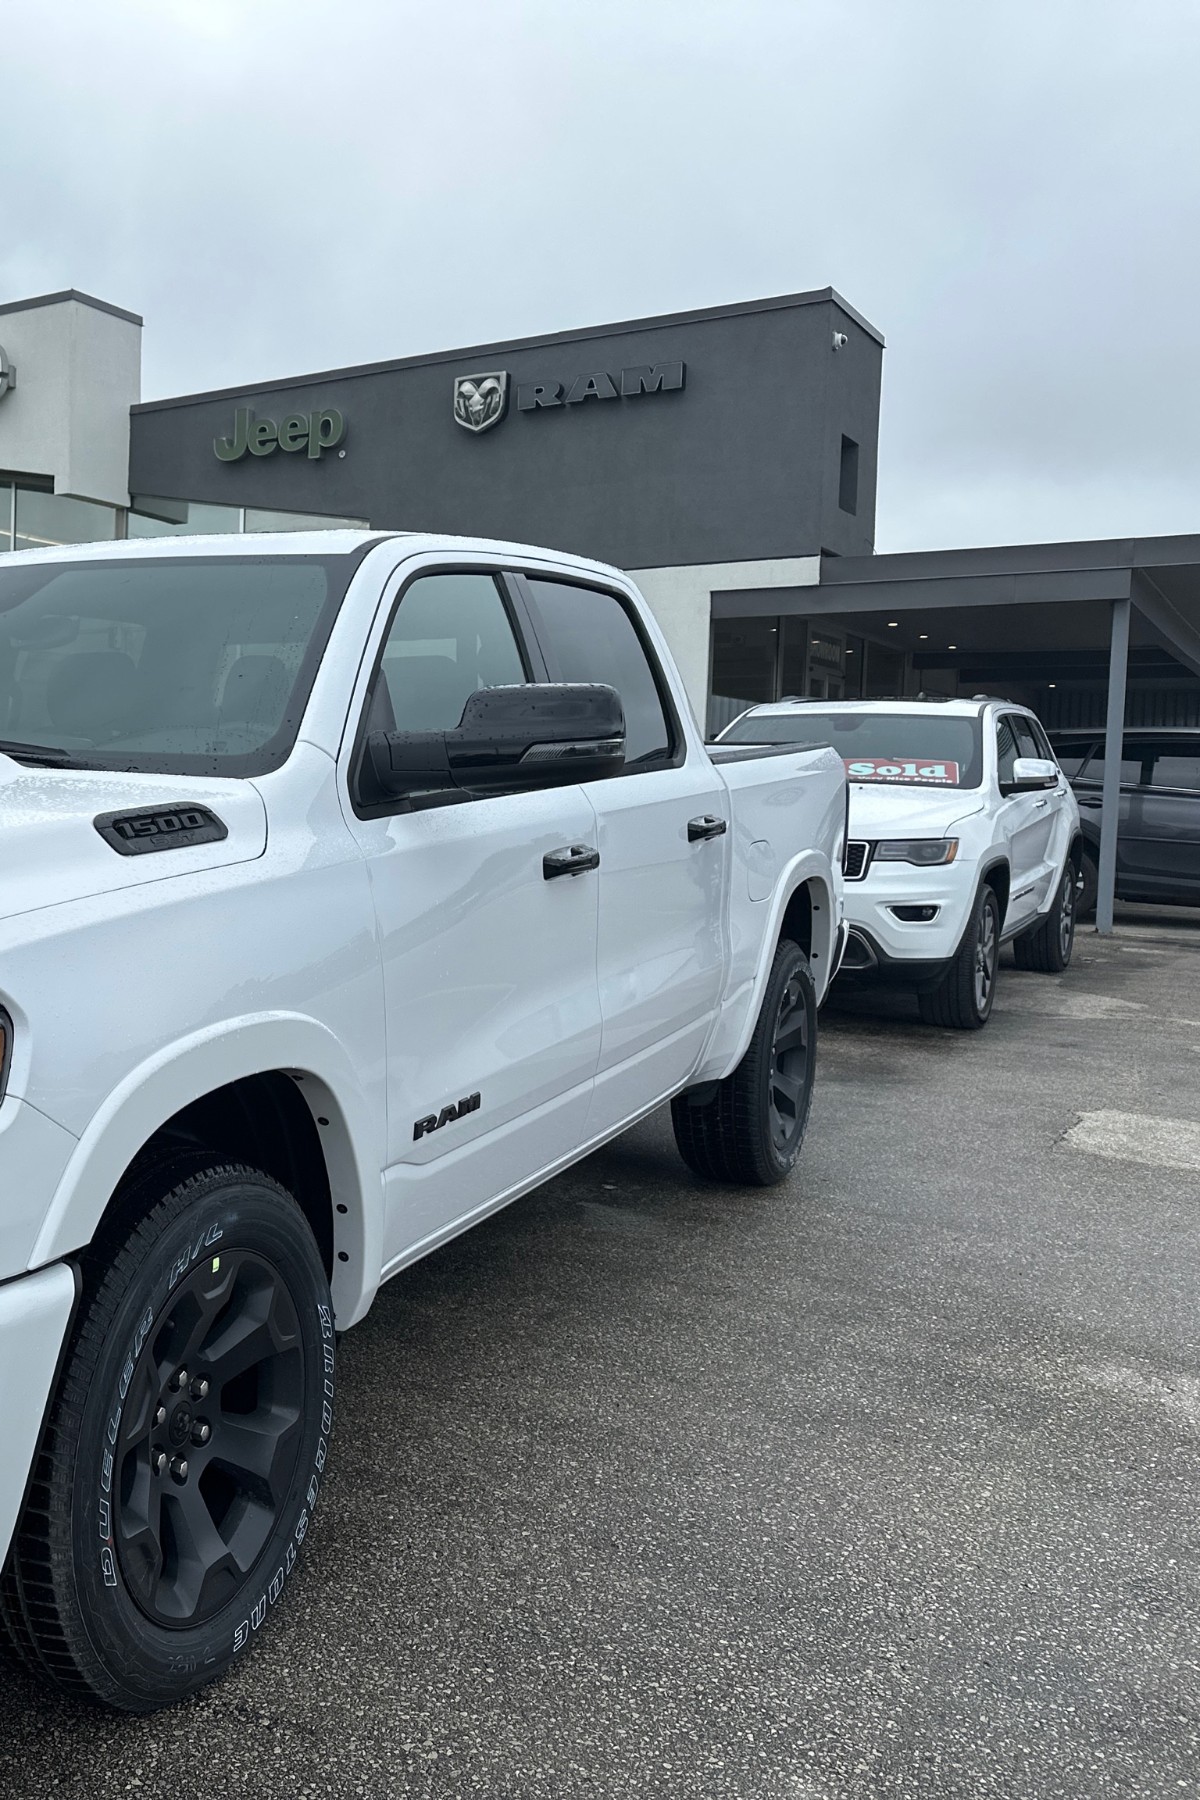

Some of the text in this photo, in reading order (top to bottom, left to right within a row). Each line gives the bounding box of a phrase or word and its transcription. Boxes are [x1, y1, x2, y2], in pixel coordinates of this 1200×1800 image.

[516, 360, 686, 411] RAM
[213, 408, 347, 460] Jeep
[848, 762, 948, 777] Sold
[113, 811, 206, 839] 1500
[413, 1091, 481, 1141] RAM
[99, 1307, 153, 1587] DUELER
[232, 1303, 335, 1653] BRIDGESTONE
